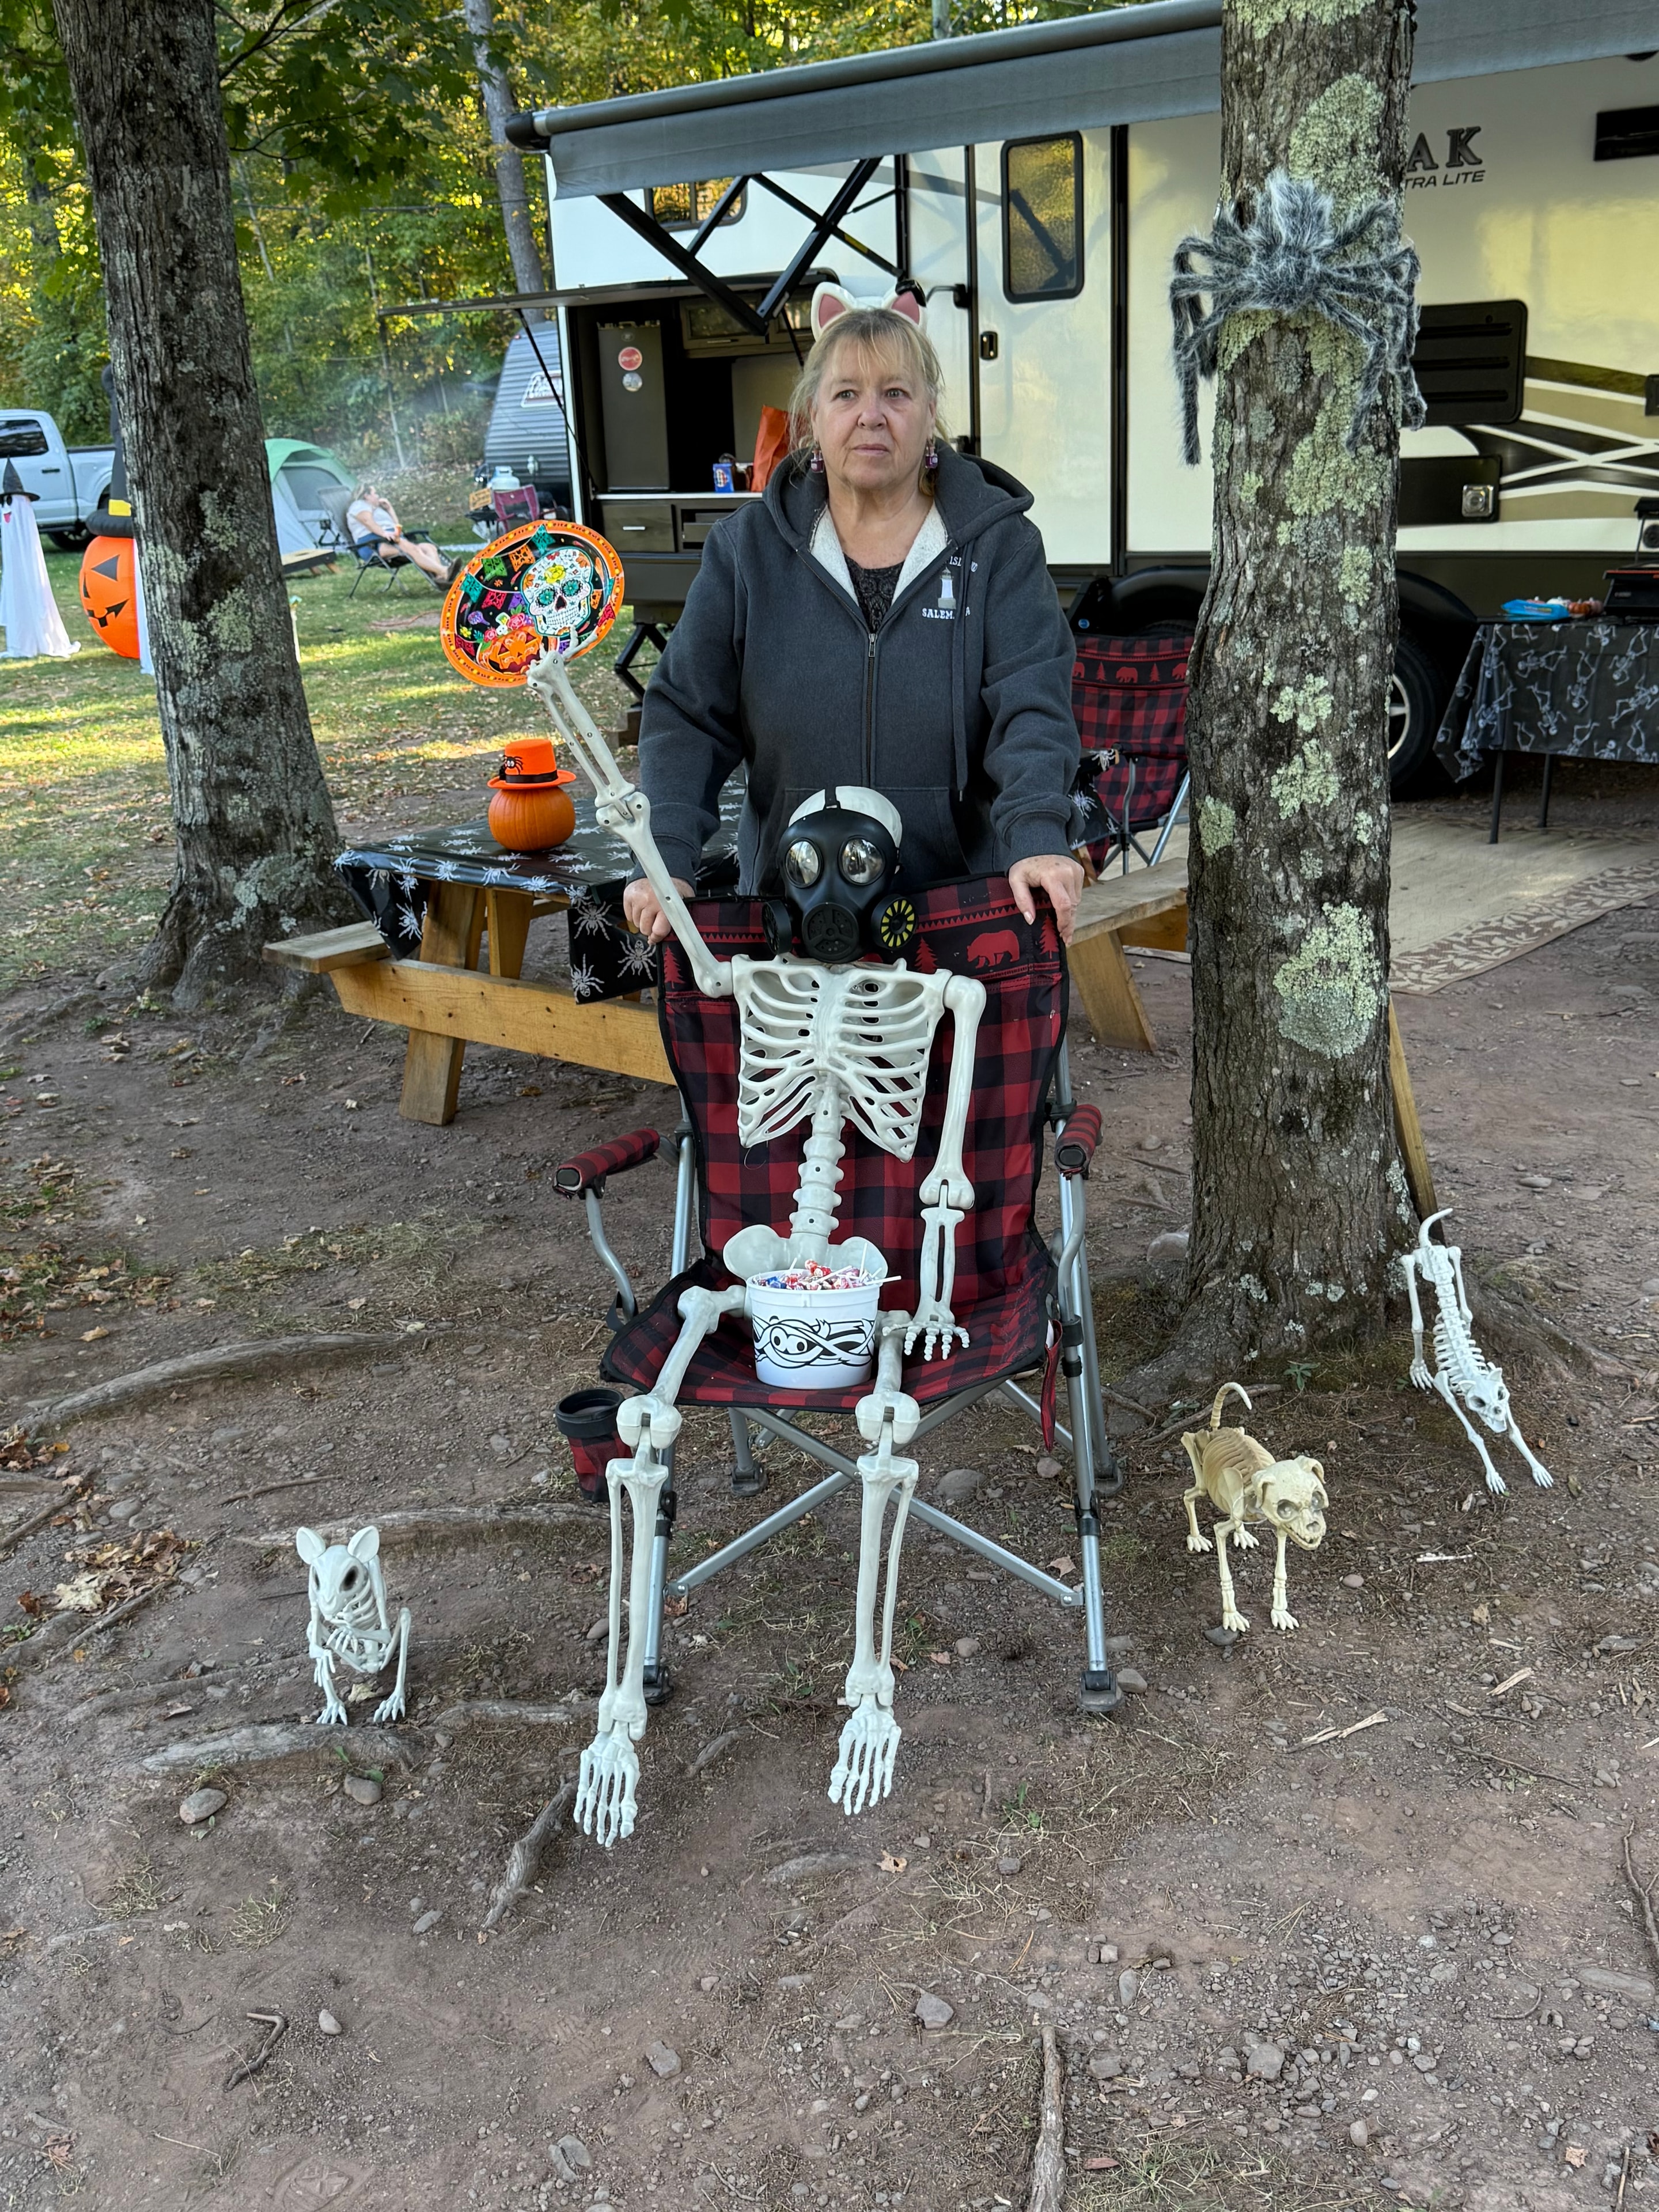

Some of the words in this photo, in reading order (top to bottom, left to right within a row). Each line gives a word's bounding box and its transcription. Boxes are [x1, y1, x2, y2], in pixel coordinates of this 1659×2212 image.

[1407, 126, 1482, 172] AK
[1405, 175, 1437, 190] TRA
[1442, 170, 1486, 186] LITE
